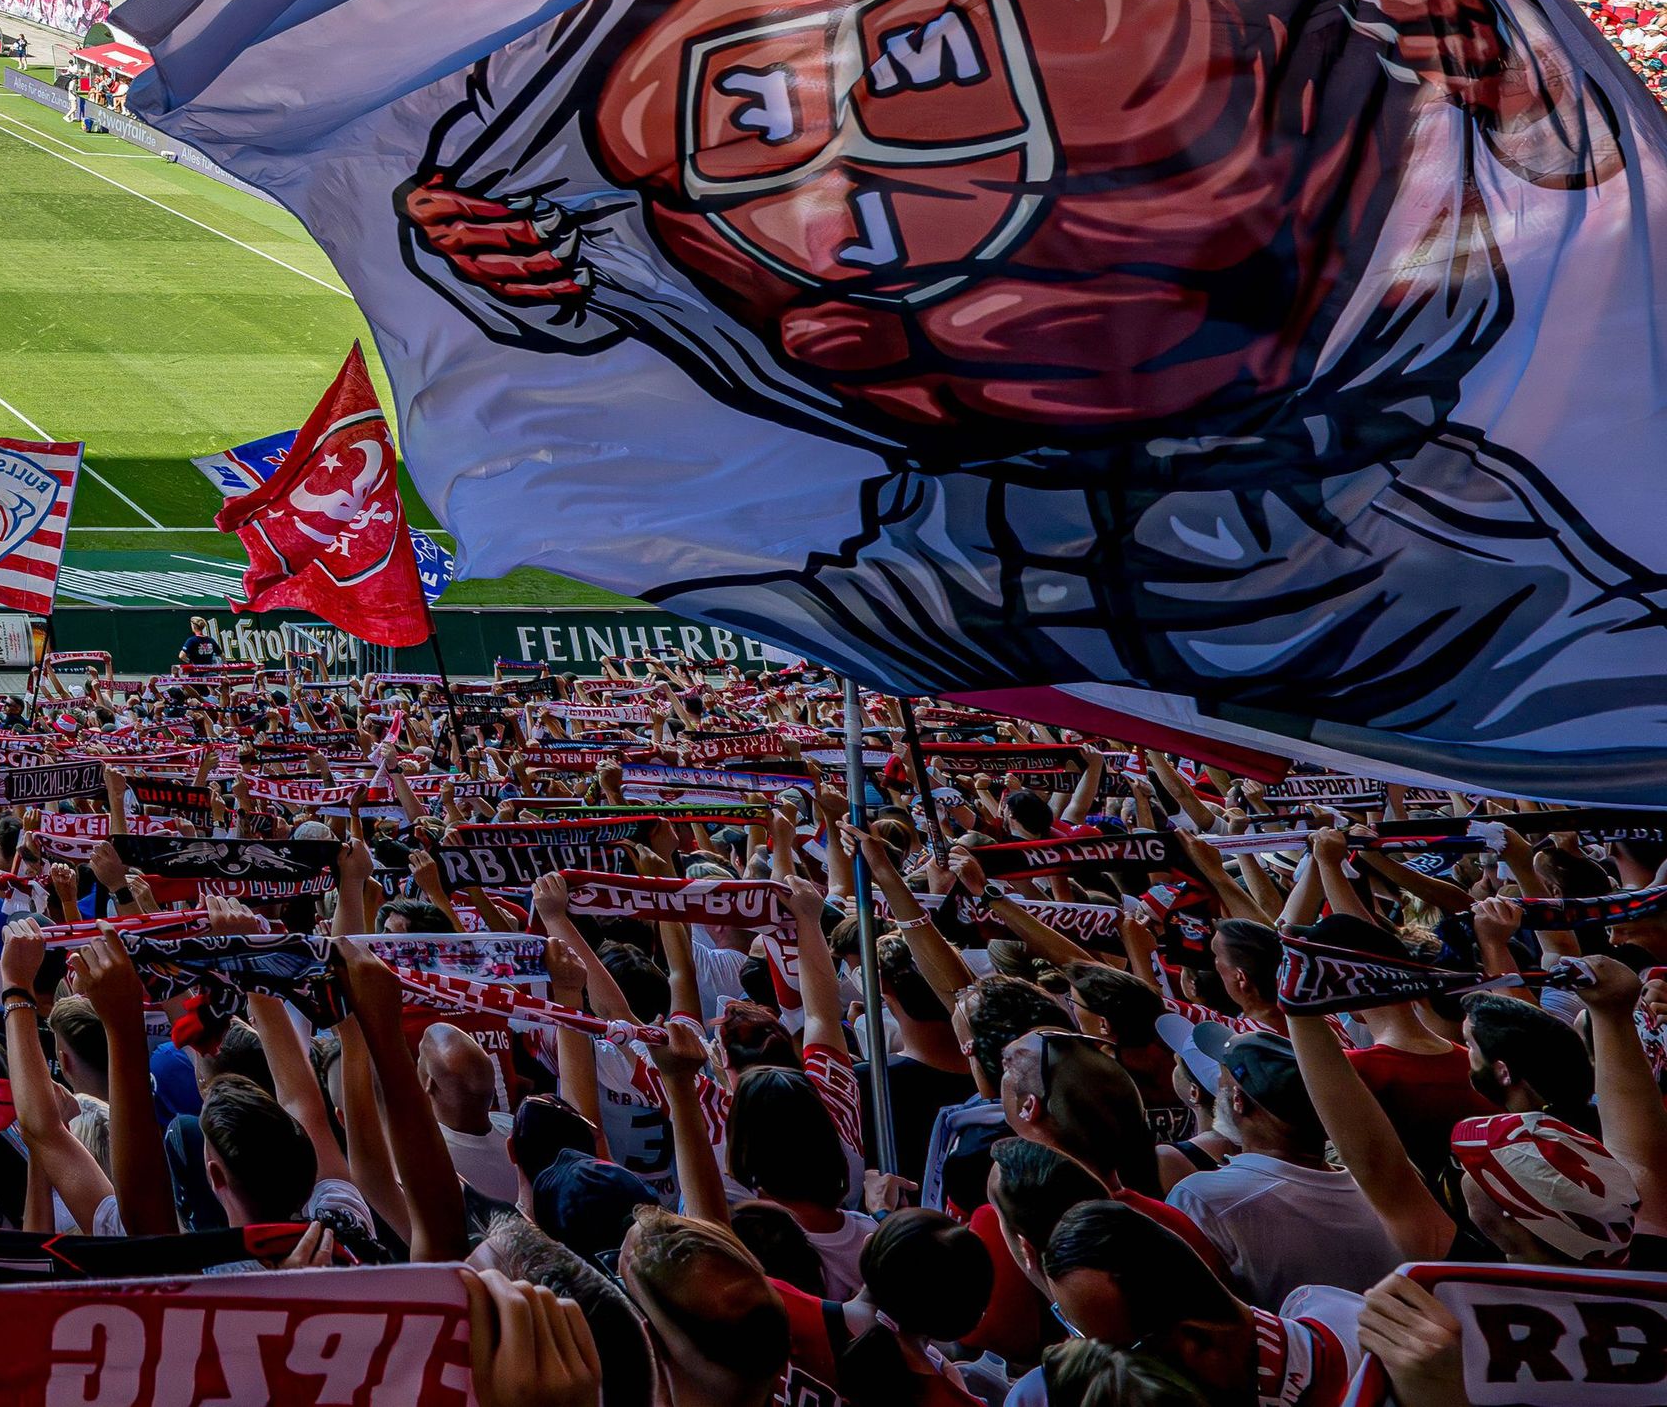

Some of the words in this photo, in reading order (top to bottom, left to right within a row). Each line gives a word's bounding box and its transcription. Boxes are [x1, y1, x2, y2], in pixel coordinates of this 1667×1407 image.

[440, 847, 503, 884] RB
[1027, 846, 1056, 867] RB
[1062, 838, 1168, 863] LEIPZIG
